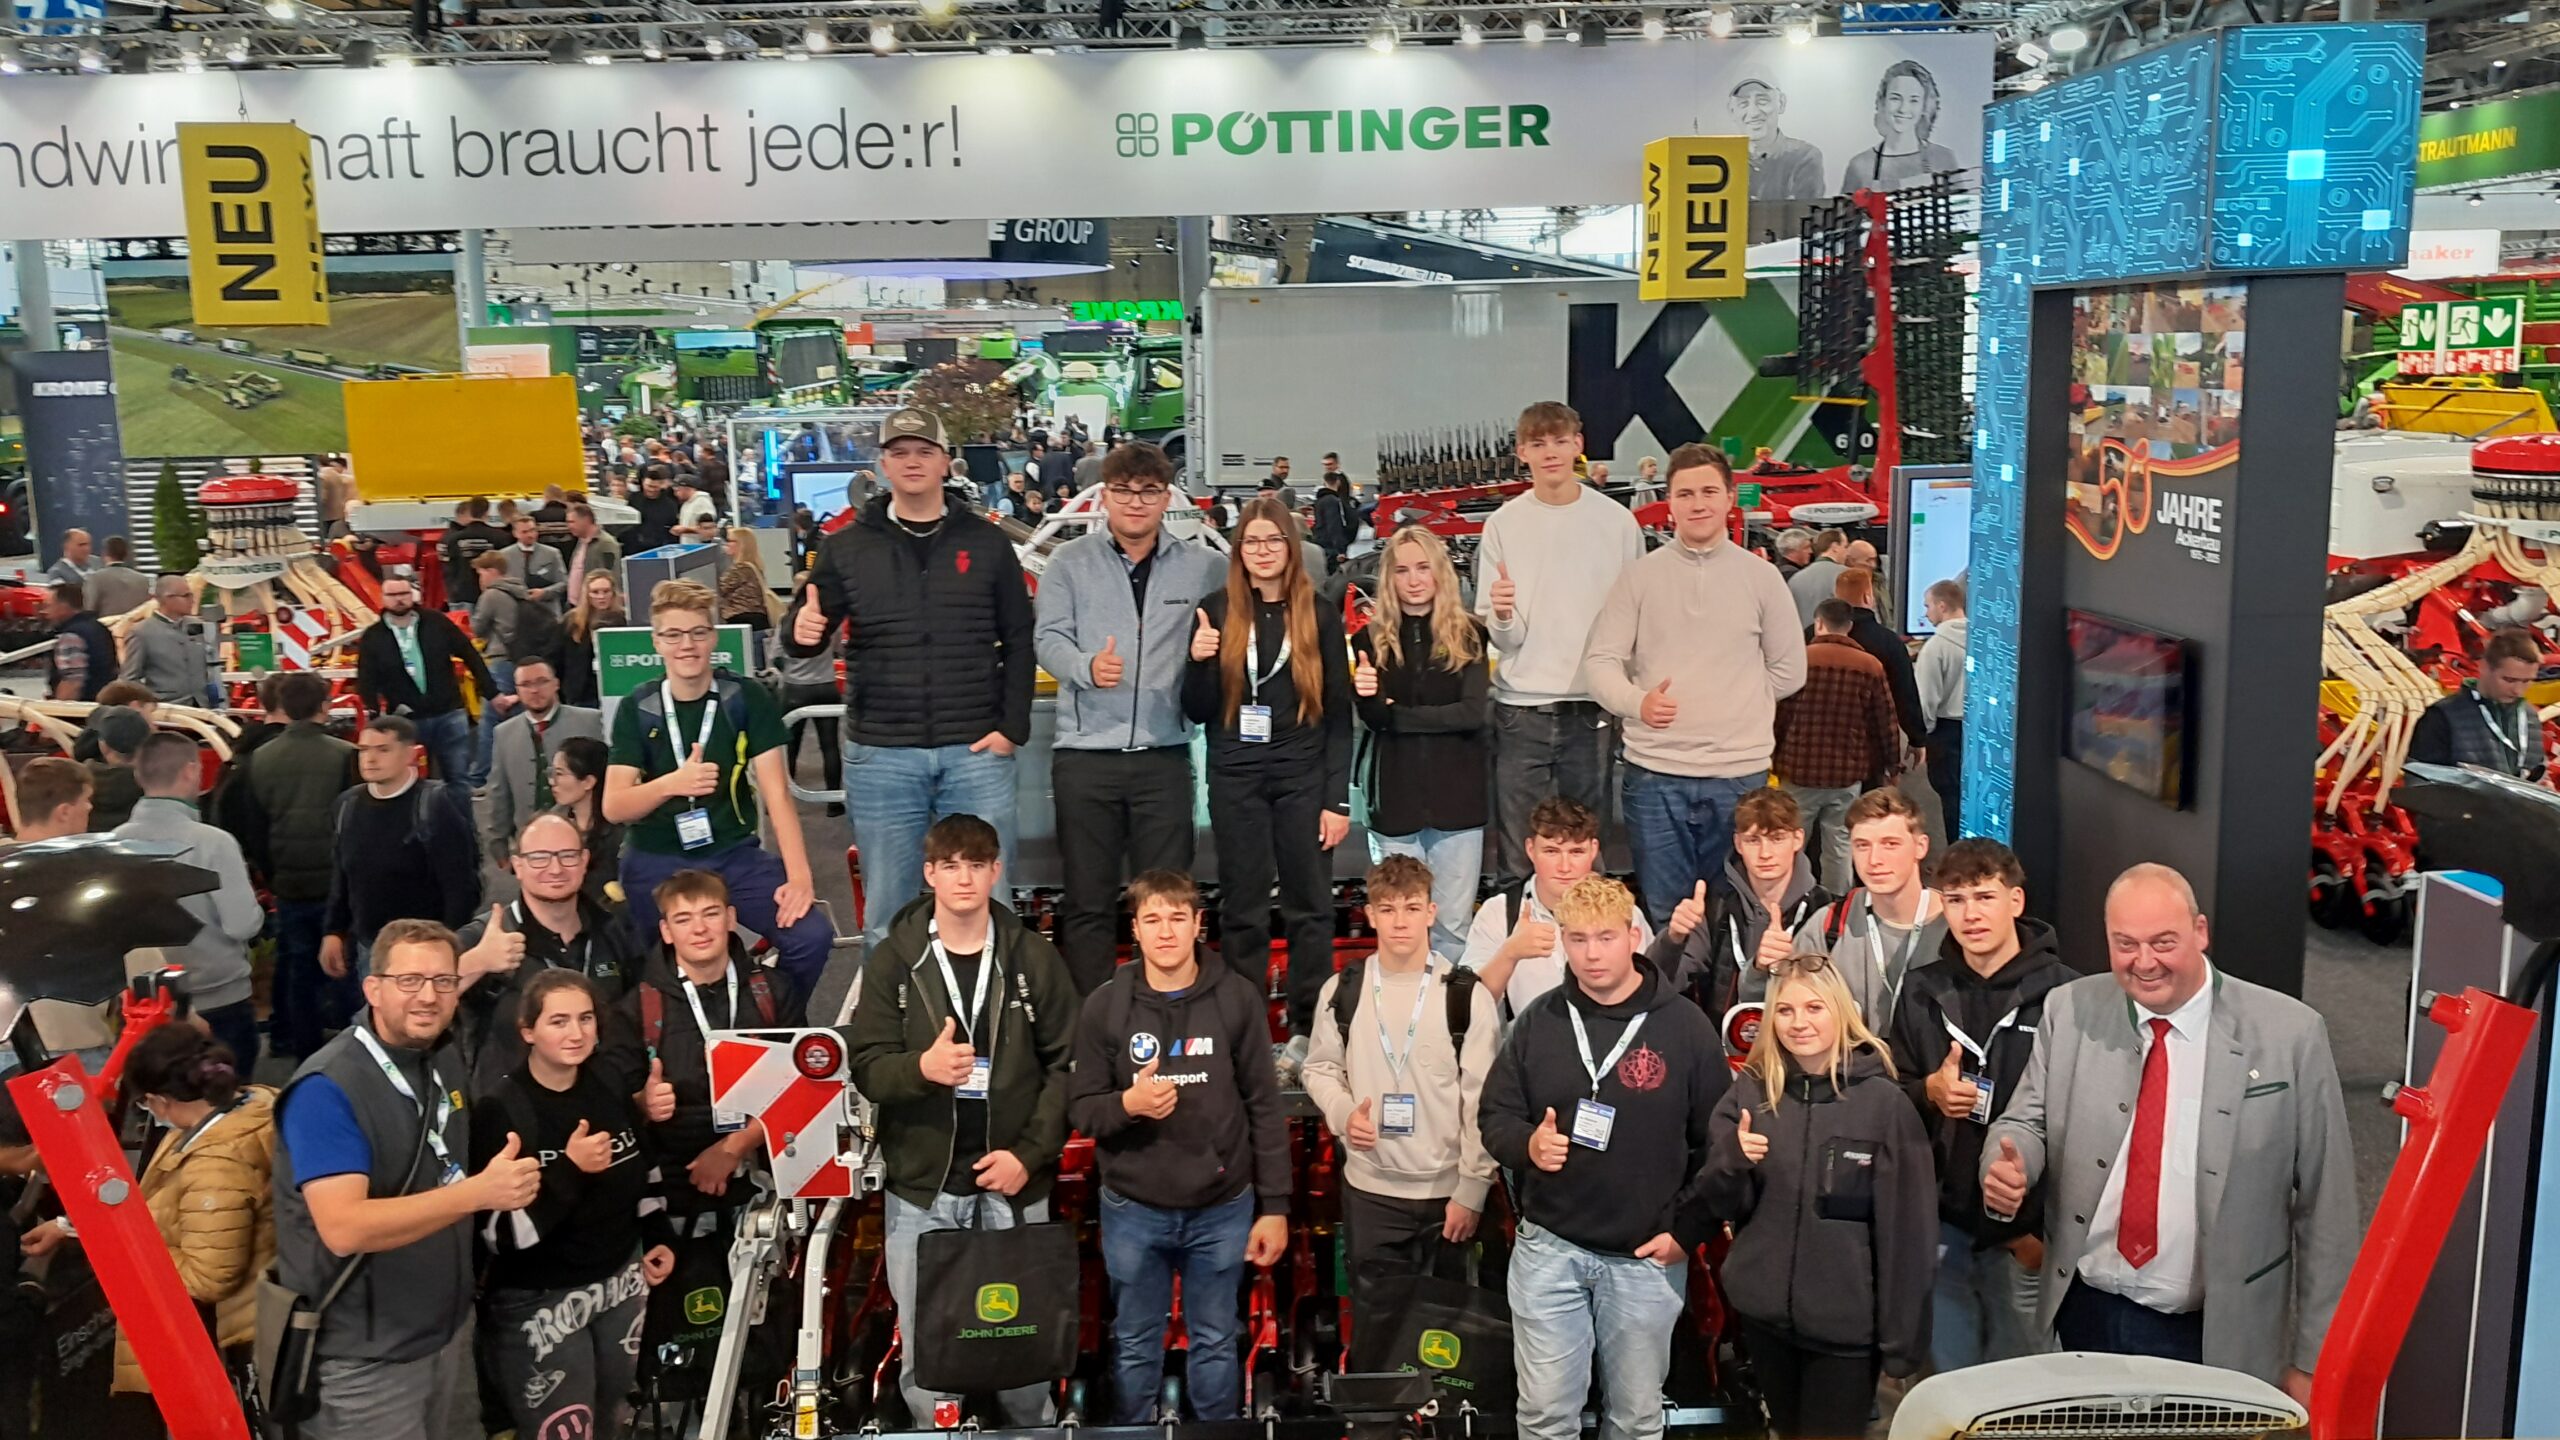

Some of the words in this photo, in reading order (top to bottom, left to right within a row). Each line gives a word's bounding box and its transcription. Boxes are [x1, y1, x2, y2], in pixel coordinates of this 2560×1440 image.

[450, 110, 721, 178] braucht
[745, 105, 962, 188] jede:r!
[204, 144, 281, 301] NEU
[1014, 218, 1094, 245] GROUP
[1647, 162, 1661, 281] NEW
[1686, 155, 1730, 280] NEU
[1835, 433, 1875, 449] 60
[2156, 491, 2223, 533] JAHRE
[1133, 1071, 1208, 1087] torsport
[956, 1327, 994, 1339] JOHN
[995, 1324, 1039, 1337] DEERE
[1438, 1376, 1475, 1391] EERE
